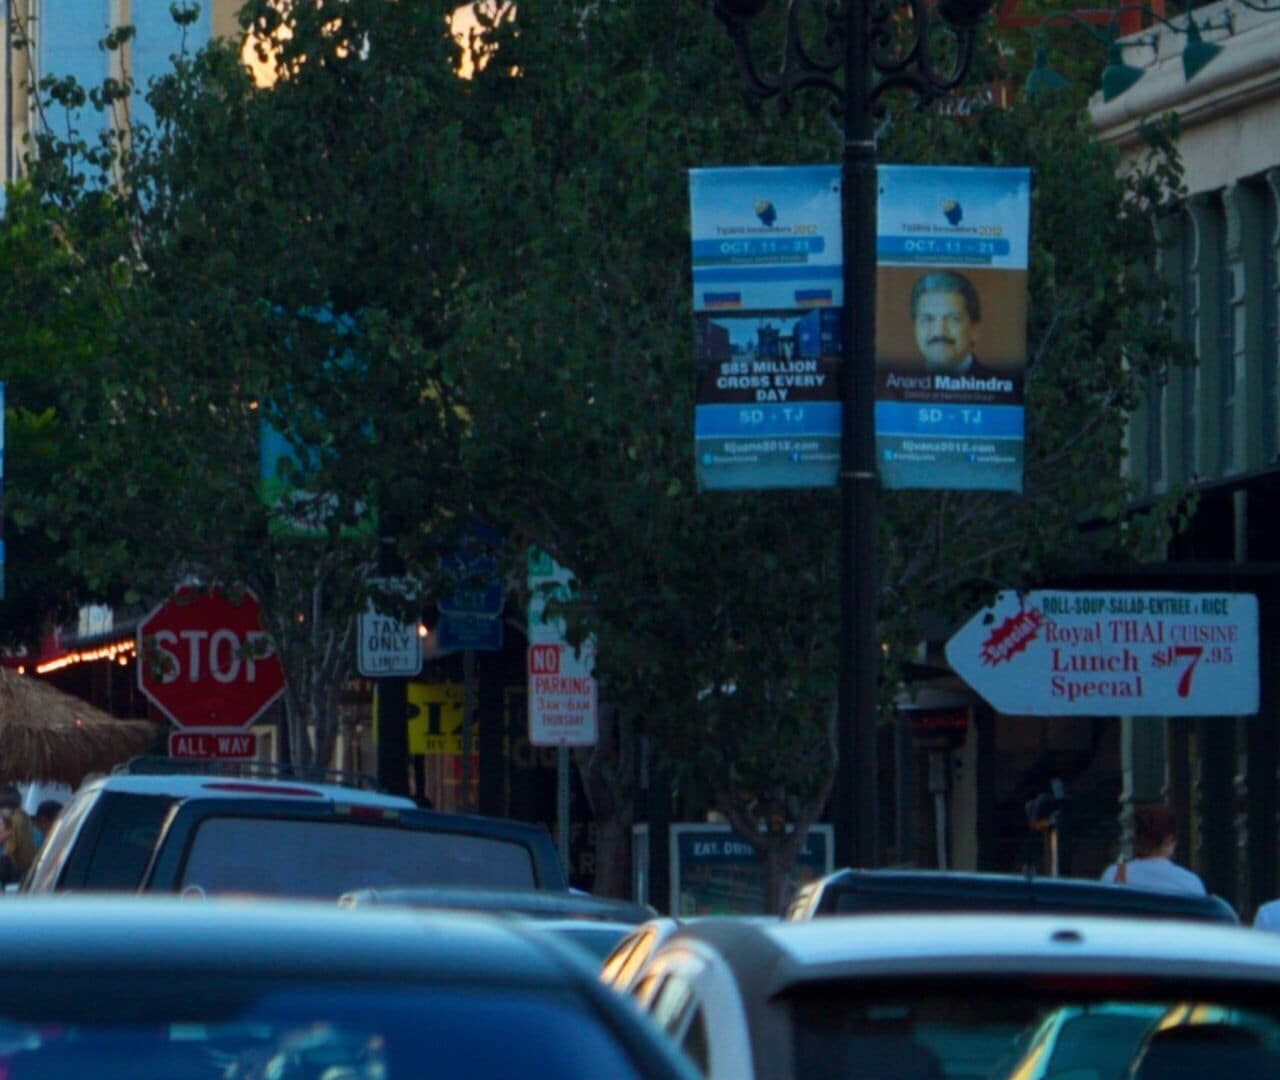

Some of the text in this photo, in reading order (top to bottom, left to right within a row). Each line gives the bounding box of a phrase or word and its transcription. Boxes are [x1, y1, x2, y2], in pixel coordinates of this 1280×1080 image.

[753, 360, 817, 373] MILLION
[716, 375, 825, 390] CROSS EVERY
[886, 373, 1014, 393] Anand Mahindra
[755, 389, 789, 401] DAY
[740, 410, 764, 423] SD
[784, 408, 804, 422] TJ
[918, 408, 943, 423] SD
[961, 410, 982, 424] TJ
[1201, 598, 1230, 616] RICE
[1045, 619, 1238, 647] Royal THAI CUISINE
[369, 636, 409, 651] ONLY
[152, 628, 276, 684] STOP
[532, 648, 557, 673] NO
[1051, 648, 1140, 673] Lunch
[535, 677, 591, 696] PARKING
[1051, 675, 1144, 702] Special
[177, 737, 250, 754] ALL WAY
